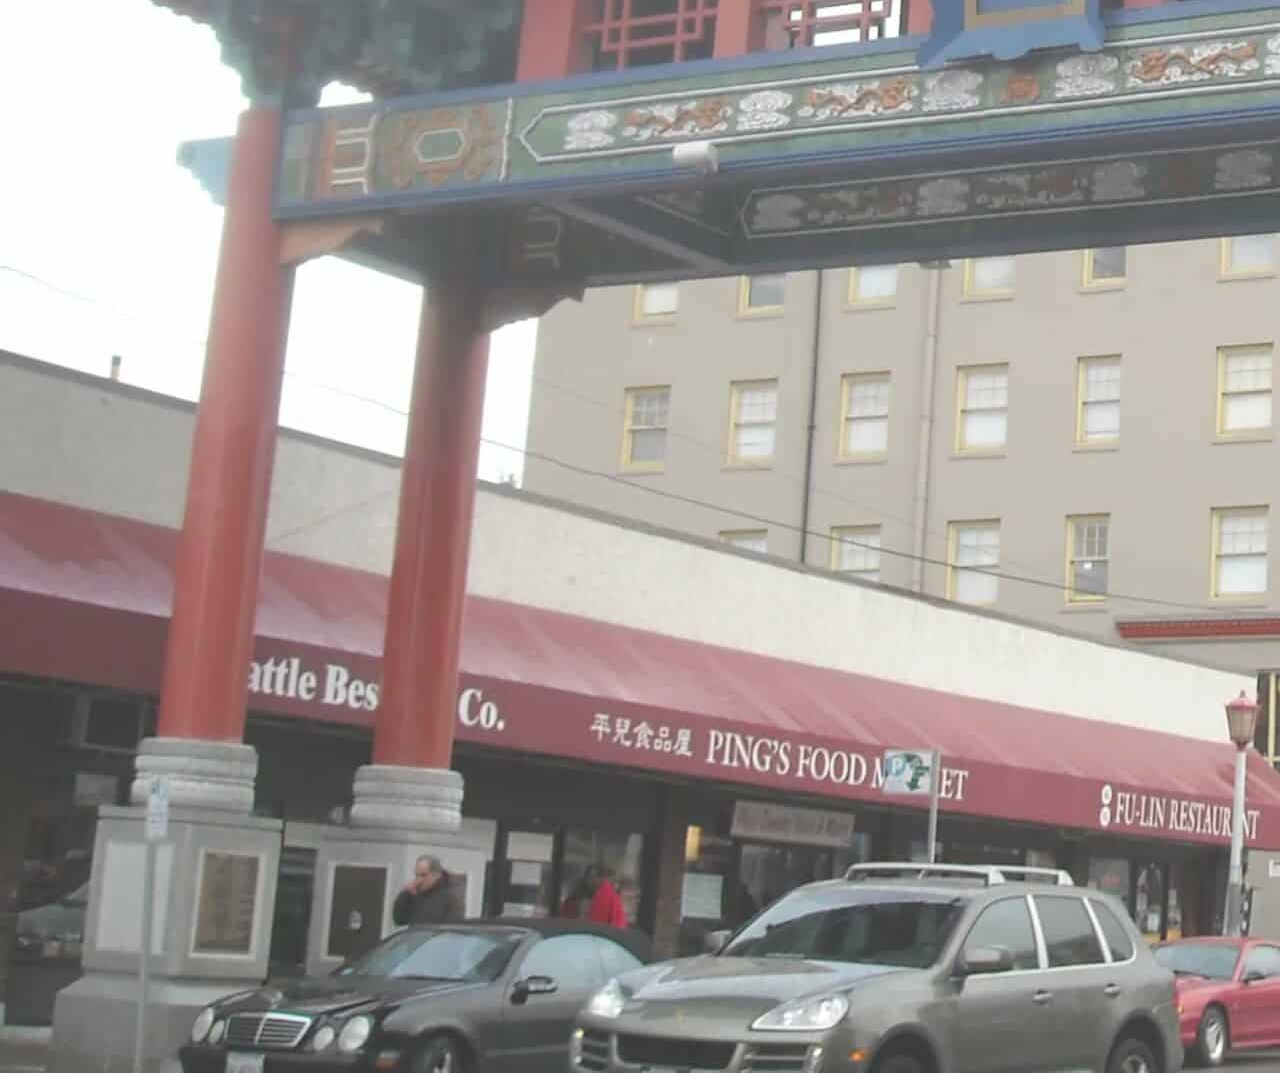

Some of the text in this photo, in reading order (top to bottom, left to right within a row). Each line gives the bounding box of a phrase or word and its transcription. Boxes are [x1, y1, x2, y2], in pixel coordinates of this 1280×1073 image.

[247, 657, 505, 731] attle Bes Co.
[706, 728, 791, 776] PING'S
[796, 744, 868, 786] FOOD
[1168, 798, 1260, 840] RESTAURNT
